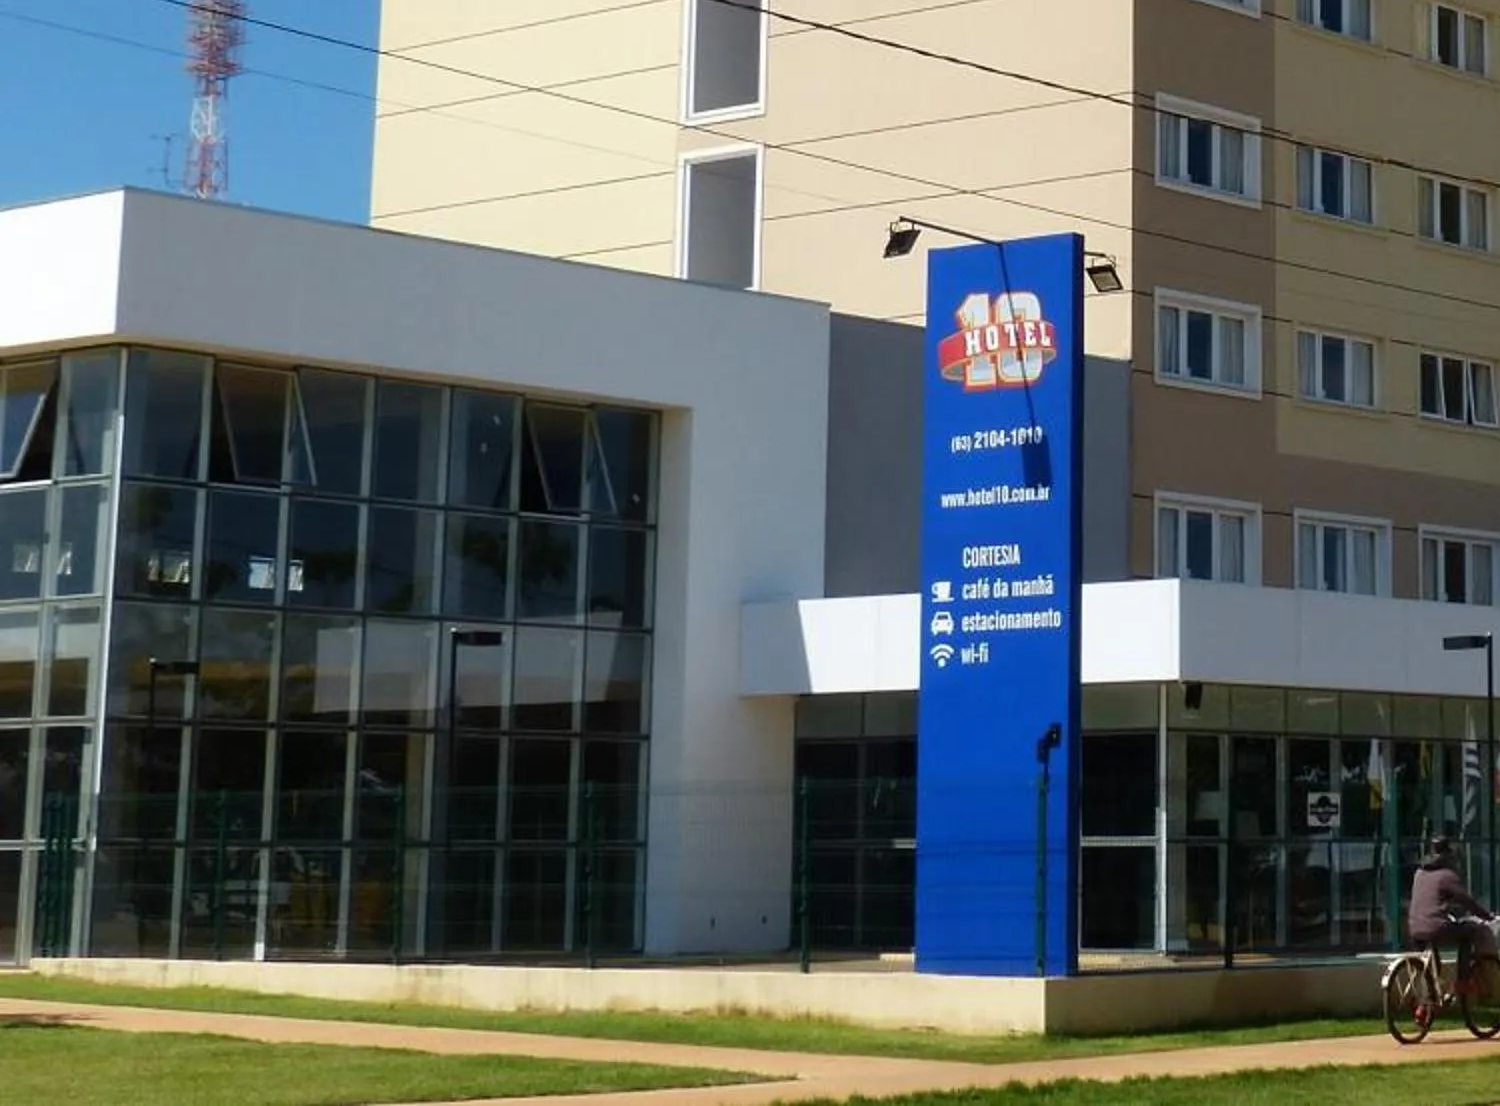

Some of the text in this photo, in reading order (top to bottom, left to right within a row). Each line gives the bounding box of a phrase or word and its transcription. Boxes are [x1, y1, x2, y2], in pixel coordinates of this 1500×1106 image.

[965, 320, 1051, 357] HOTEL
[973, 425, 1043, 449] 2104-1010
[940, 483, 1050, 509] www.hotel10.com.br
[962, 543, 1021, 569] CORTESIA
[961, 573, 1054, 601] café da manhã
[961, 607, 1062, 633] estacionamento
[960, 641, 989, 665] wi-fi
